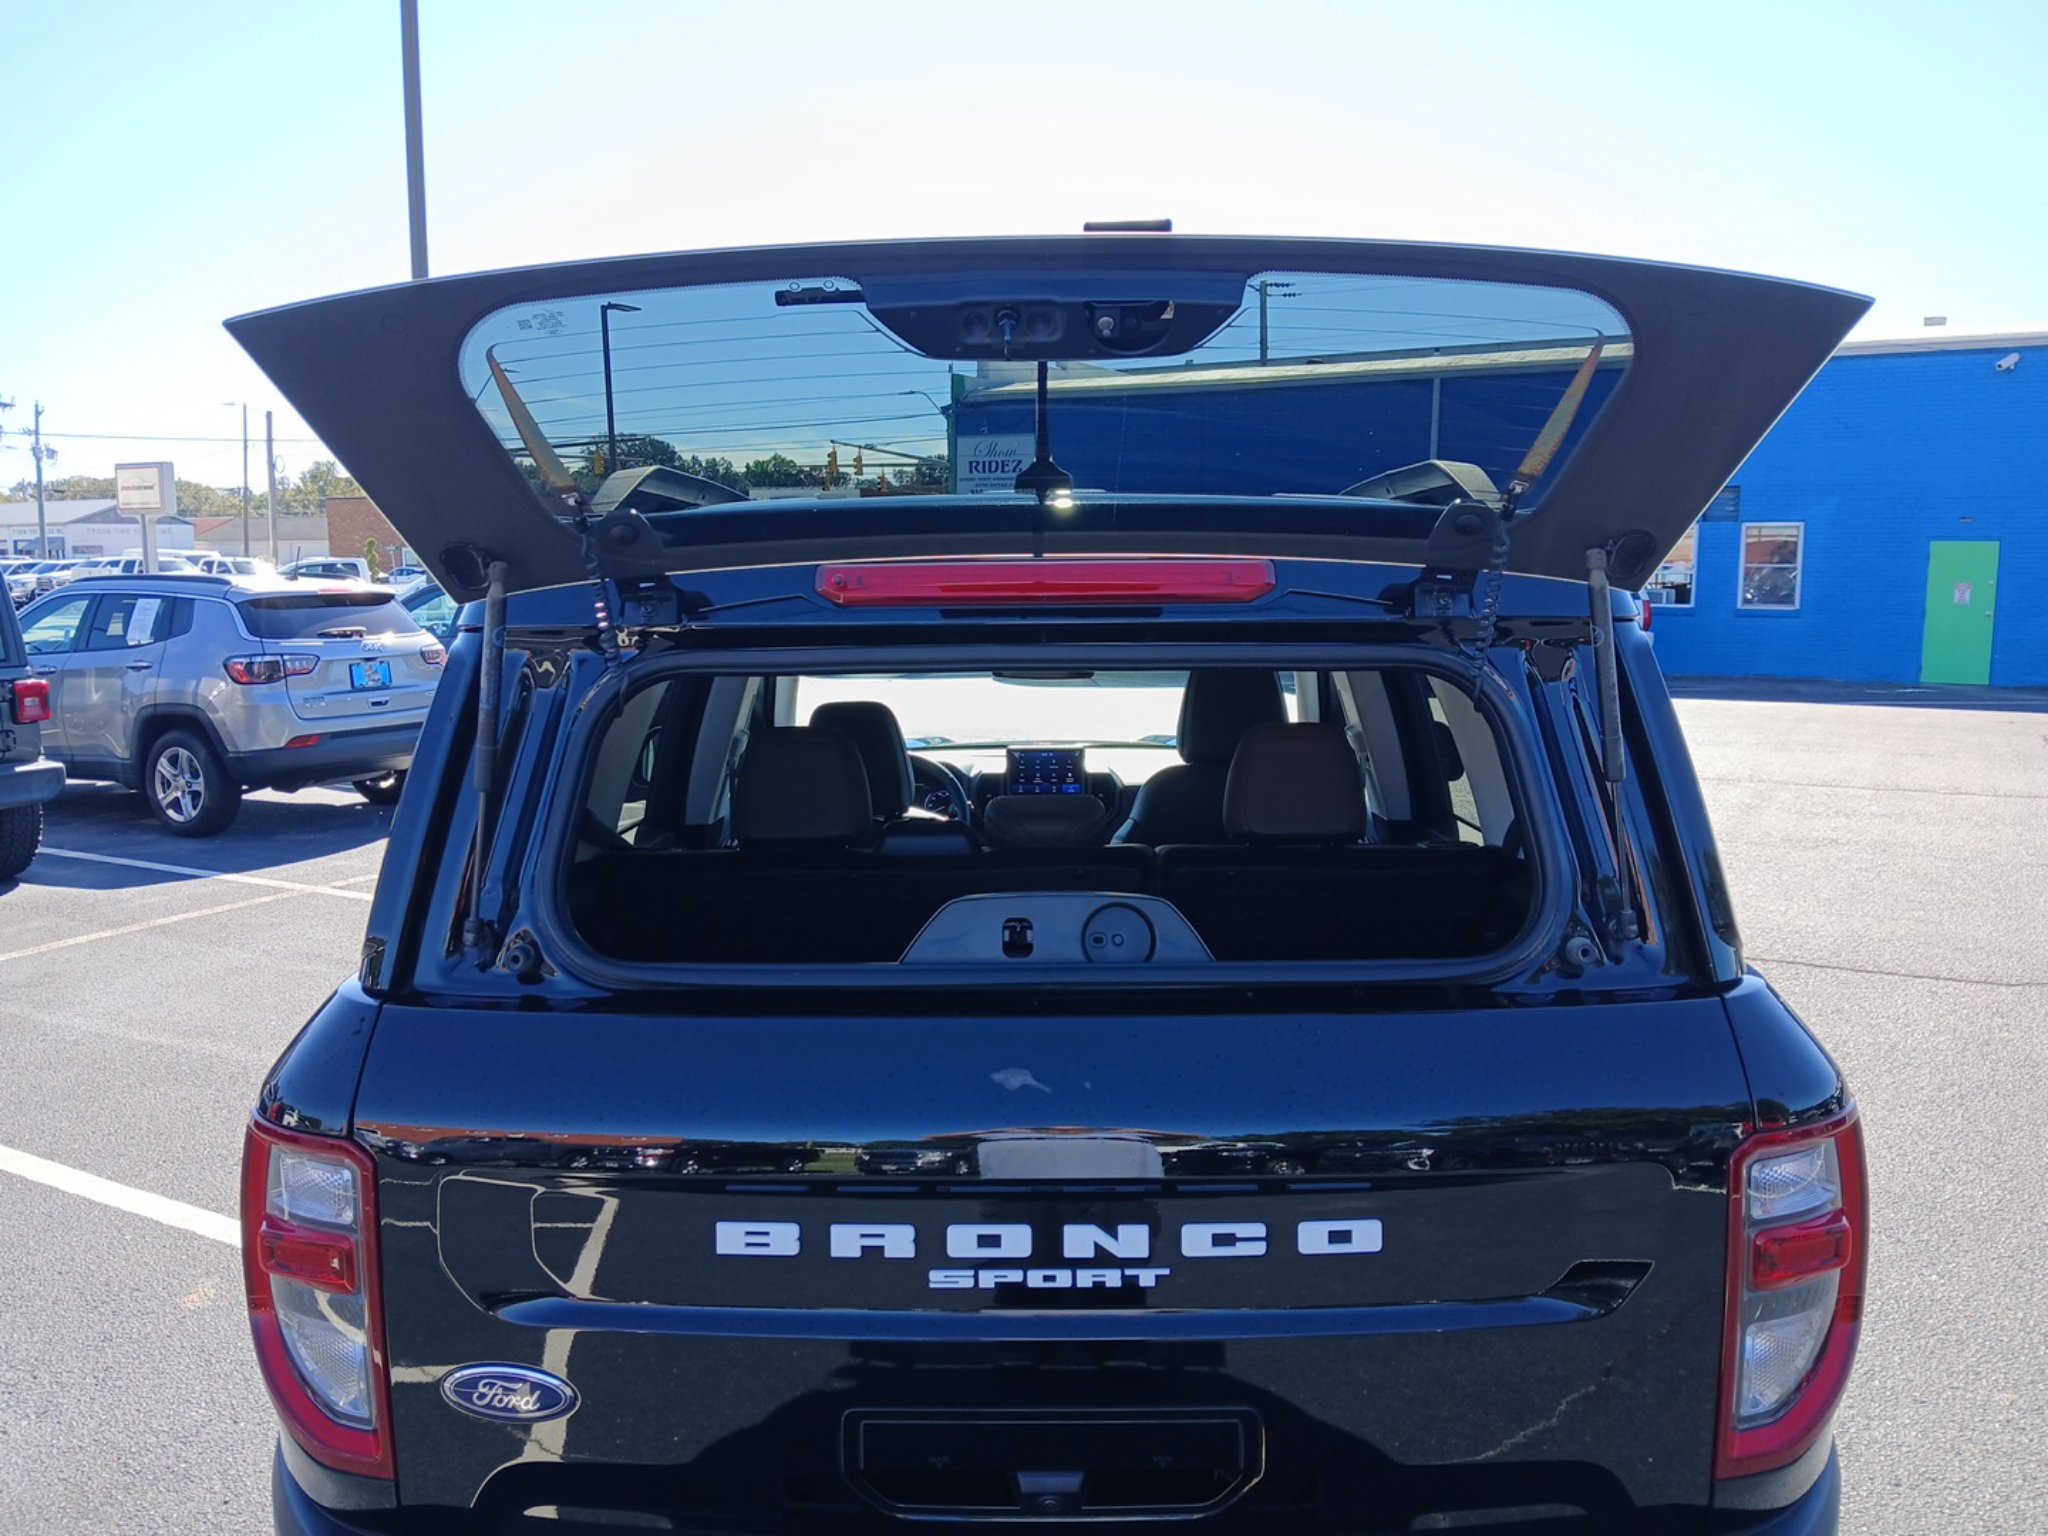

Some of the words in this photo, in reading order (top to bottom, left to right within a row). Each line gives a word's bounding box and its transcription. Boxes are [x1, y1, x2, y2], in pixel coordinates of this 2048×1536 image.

[973, 440, 1017, 459] Show
[968, 459, 1023, 475] RIDEZ
[716, 1219, 1383, 1259] BRONCO
[929, 1267, 1171, 1289] SPORT
[472, 1378, 541, 1411] Ford
